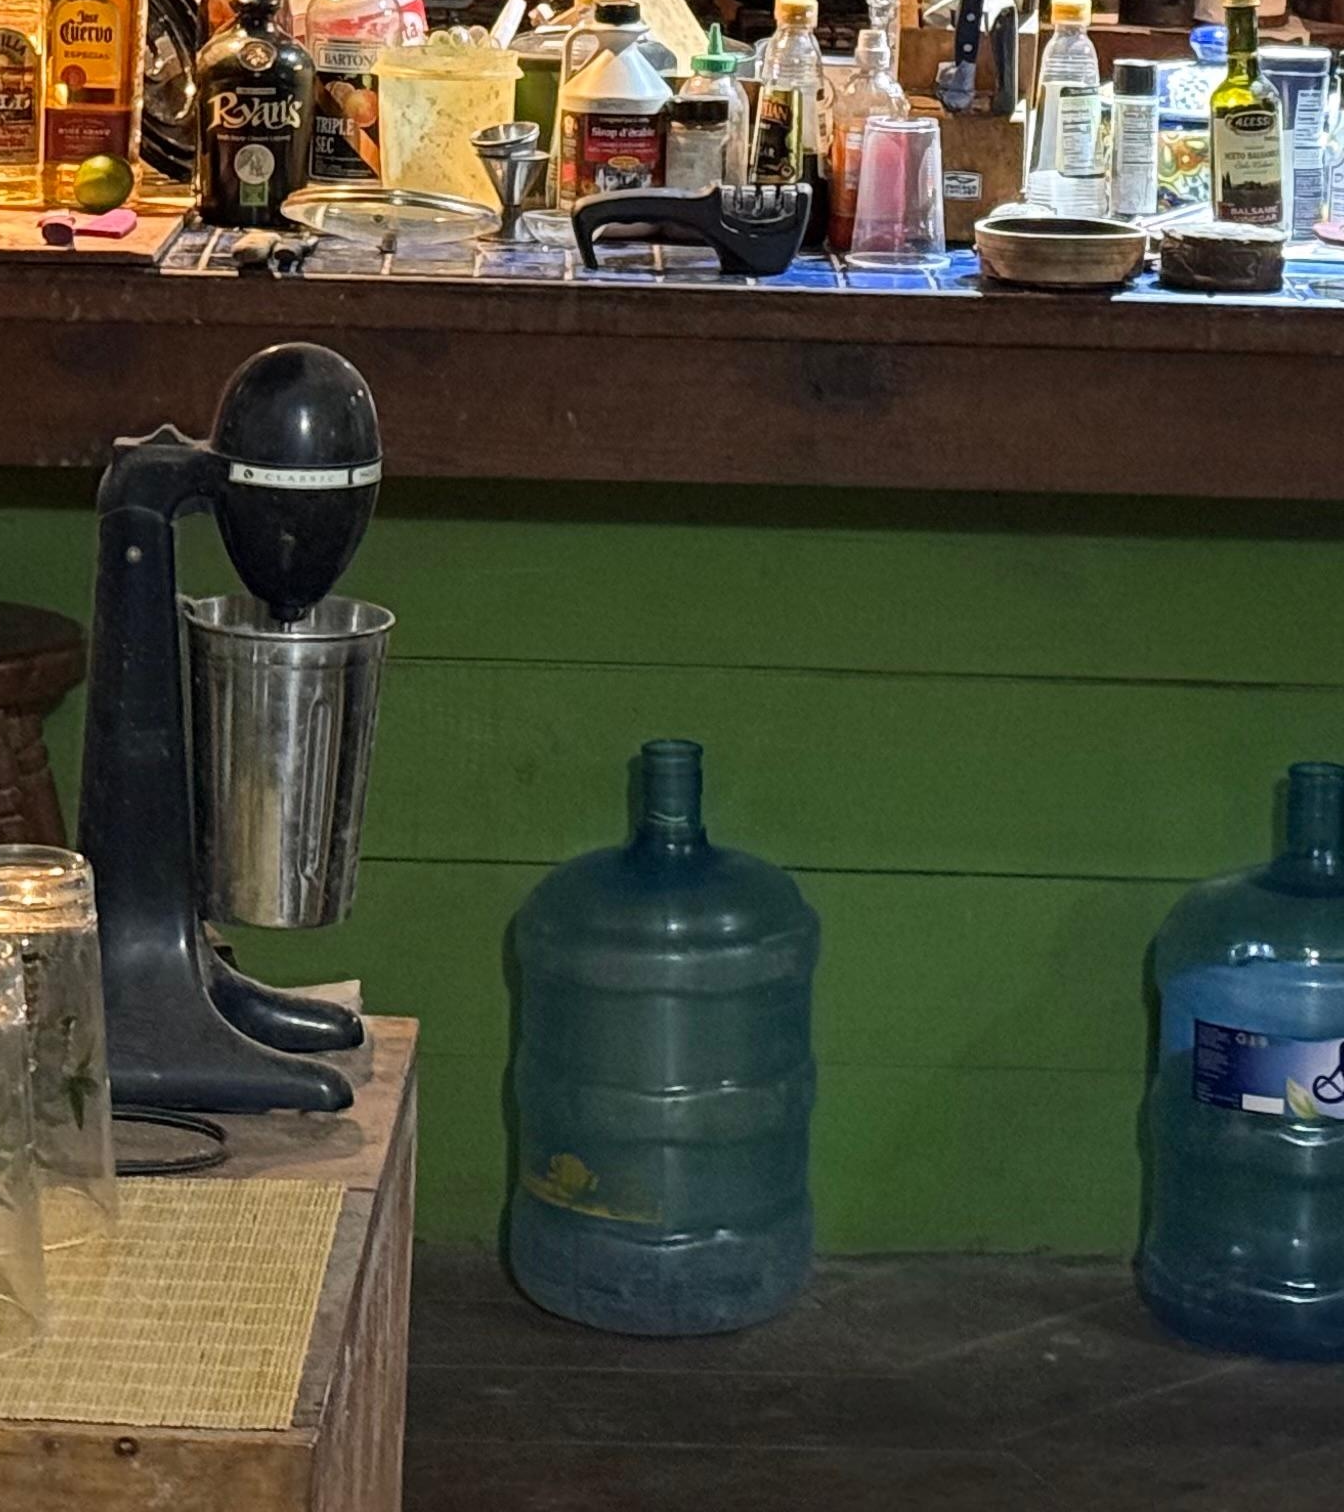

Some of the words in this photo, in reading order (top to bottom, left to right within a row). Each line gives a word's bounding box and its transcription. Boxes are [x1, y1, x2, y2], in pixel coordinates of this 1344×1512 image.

[59, 19, 113, 45] Cuervo
[324, 53, 376, 68] BARTON
[207, 92, 303, 131] Ryan's
[316, 116, 355, 136] TRIPLE
[315, 136, 335, 154] SEC
[264, 472, 334, 484] CLASSIC
